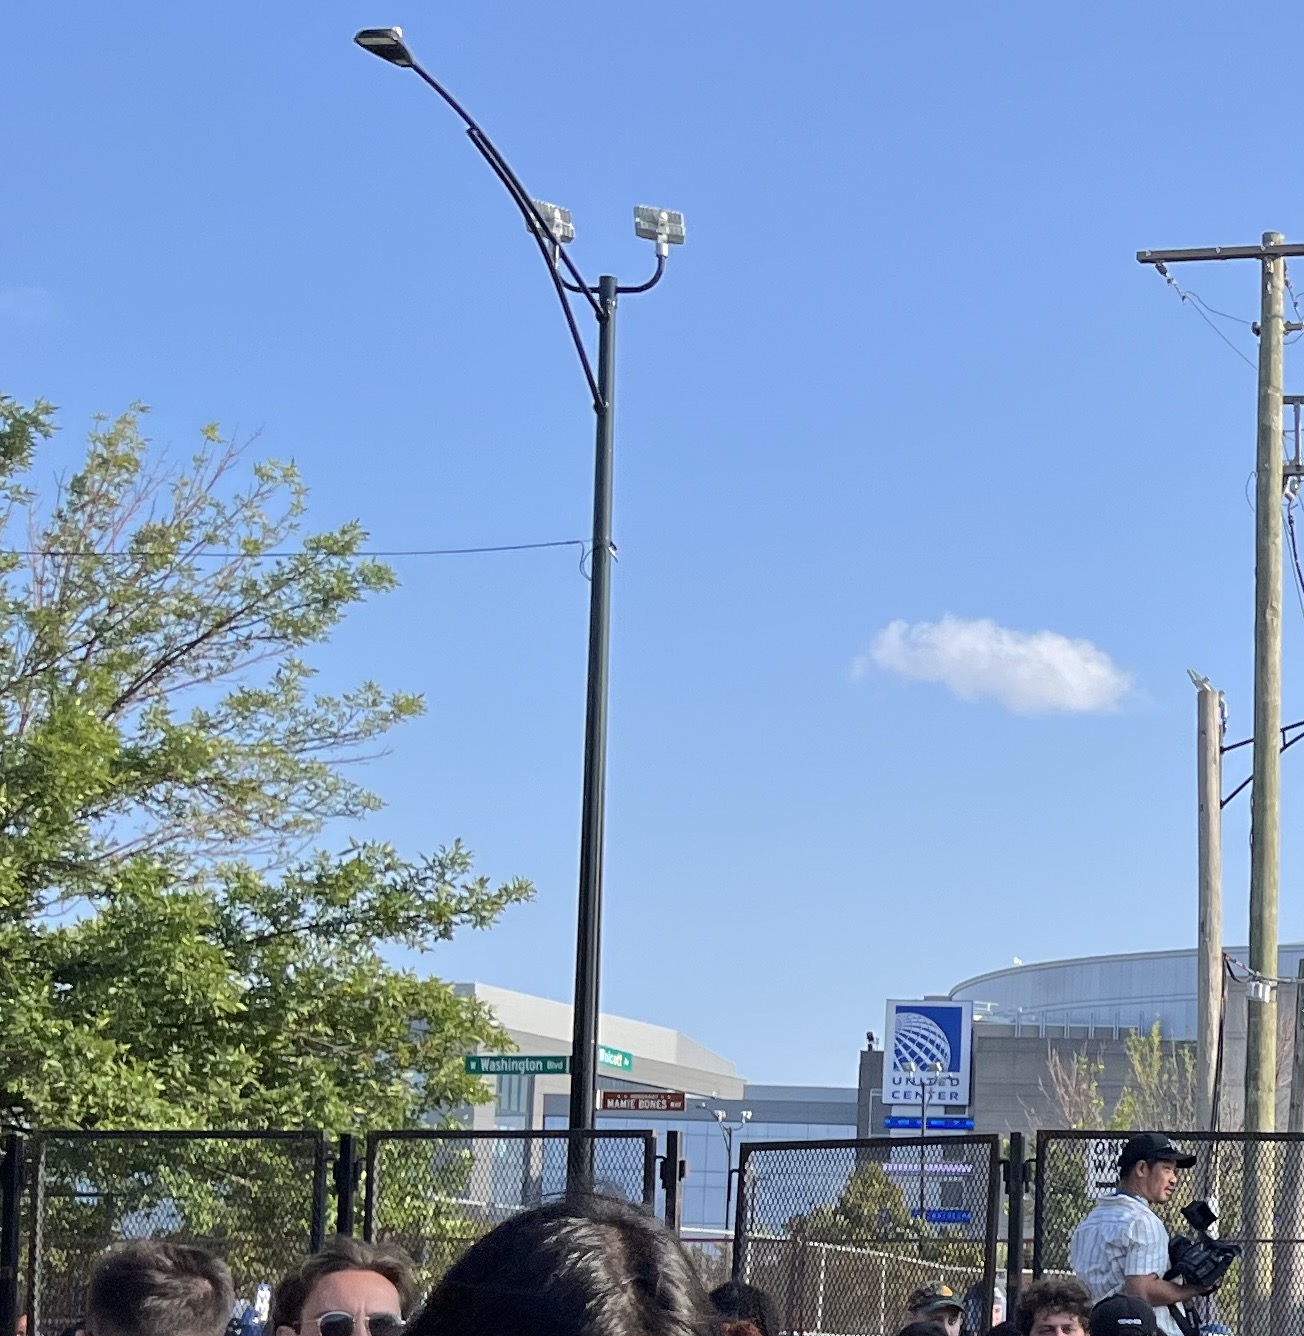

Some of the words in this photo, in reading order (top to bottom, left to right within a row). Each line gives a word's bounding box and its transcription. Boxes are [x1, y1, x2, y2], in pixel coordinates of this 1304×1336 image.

[481, 1057, 543, 1074] Washington
[892, 1075, 960, 1087] UNITED
[892, 1090, 959, 1101] CENTER
